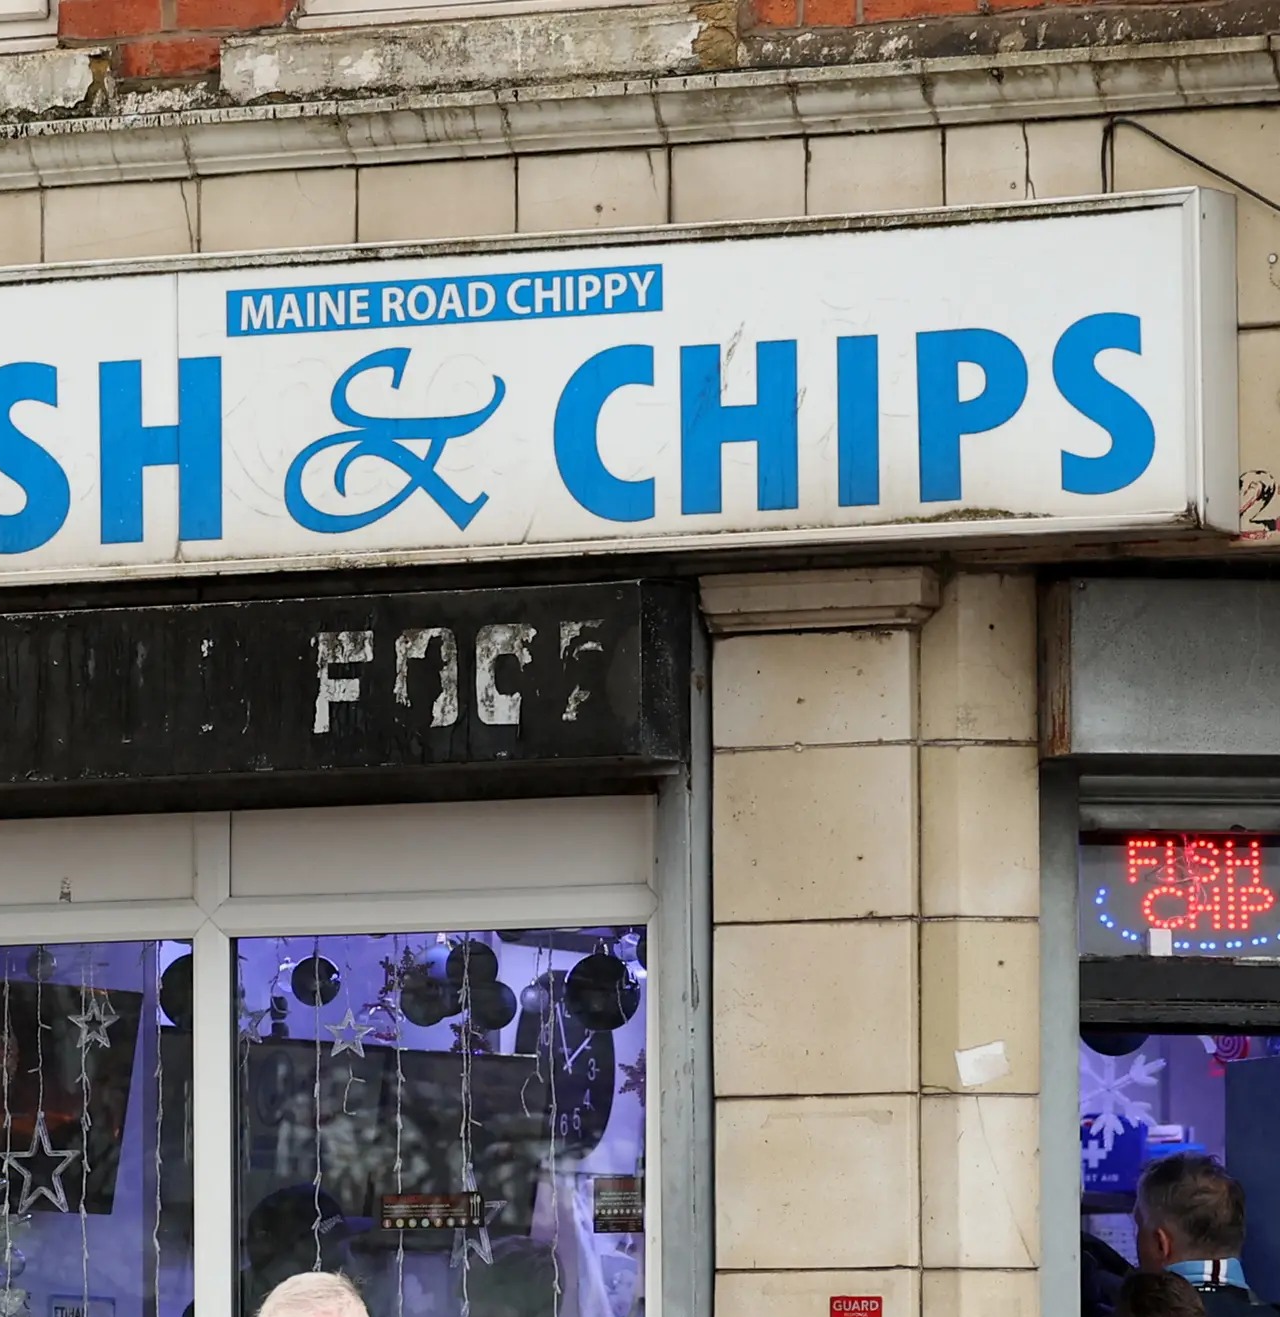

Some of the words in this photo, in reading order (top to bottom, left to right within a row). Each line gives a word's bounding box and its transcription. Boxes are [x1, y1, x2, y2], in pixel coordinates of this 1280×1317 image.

[239, 286, 372, 332] MAINE
[381, 280, 496, 323] ROAD
[505, 269, 656, 315] CHIPPY
[284, 347, 506, 533] &
[553, 311, 1157, 524] CHIPS
[1128, 839, 1261, 885] FISH
[1142, 885, 1276, 930] CHIP
[832, 1300, 880, 1312] GUARD
